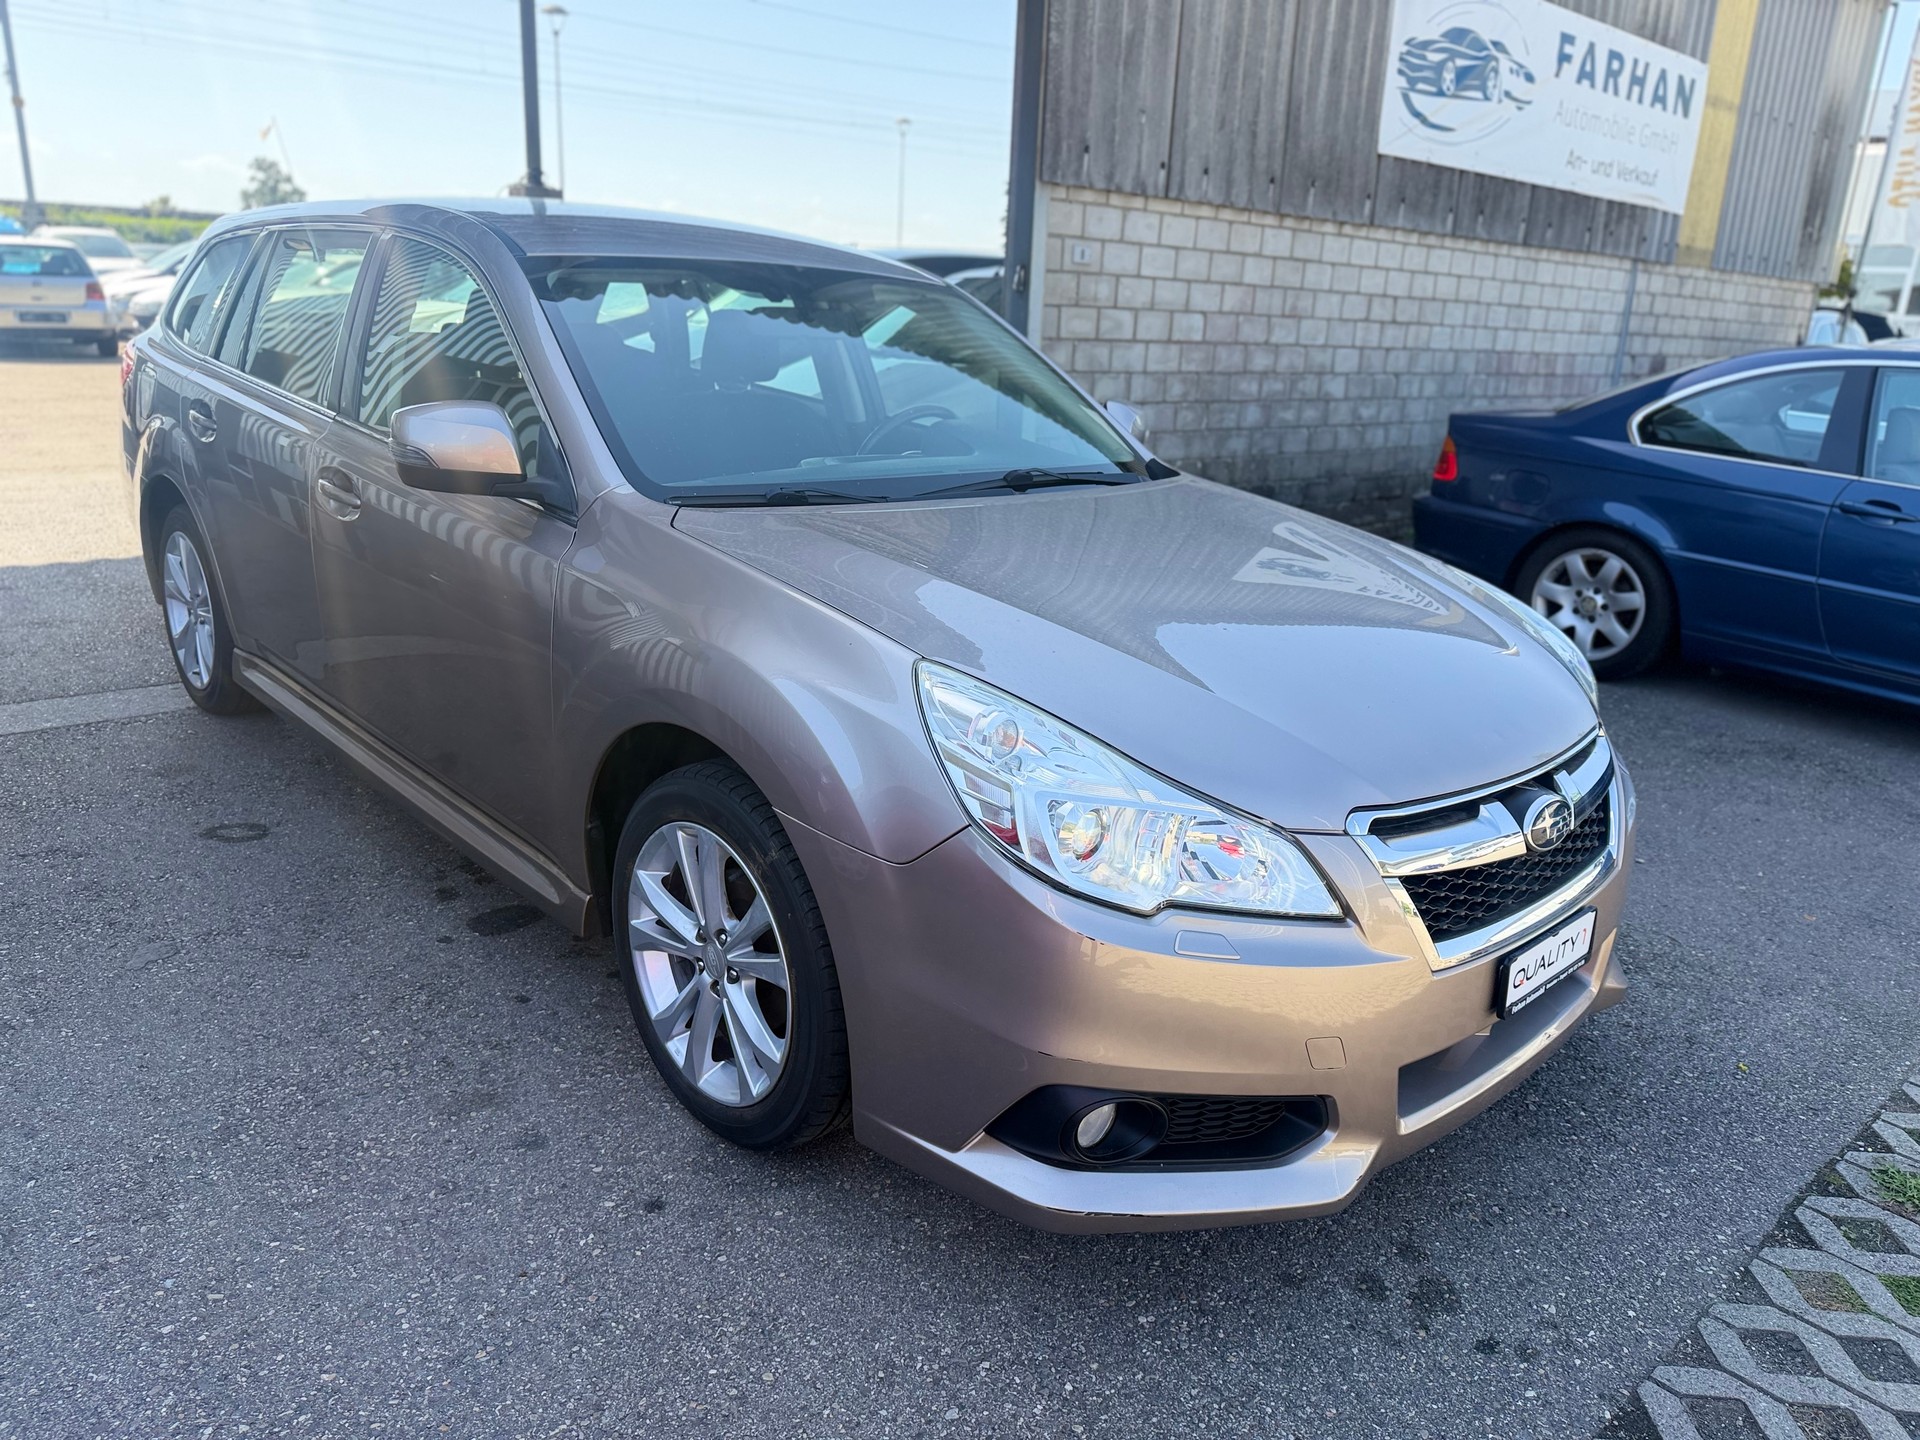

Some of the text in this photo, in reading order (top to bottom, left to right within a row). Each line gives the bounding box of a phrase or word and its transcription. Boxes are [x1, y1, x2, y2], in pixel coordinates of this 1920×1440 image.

[1554, 31, 1696, 119] FARHAN
[1553, 99, 1680, 156] Automobile GmbH
[1591, 158, 1615, 178] und
[1617, 160, 1659, 187] Verkauf
[1513, 931, 1580, 989] QUALITY
